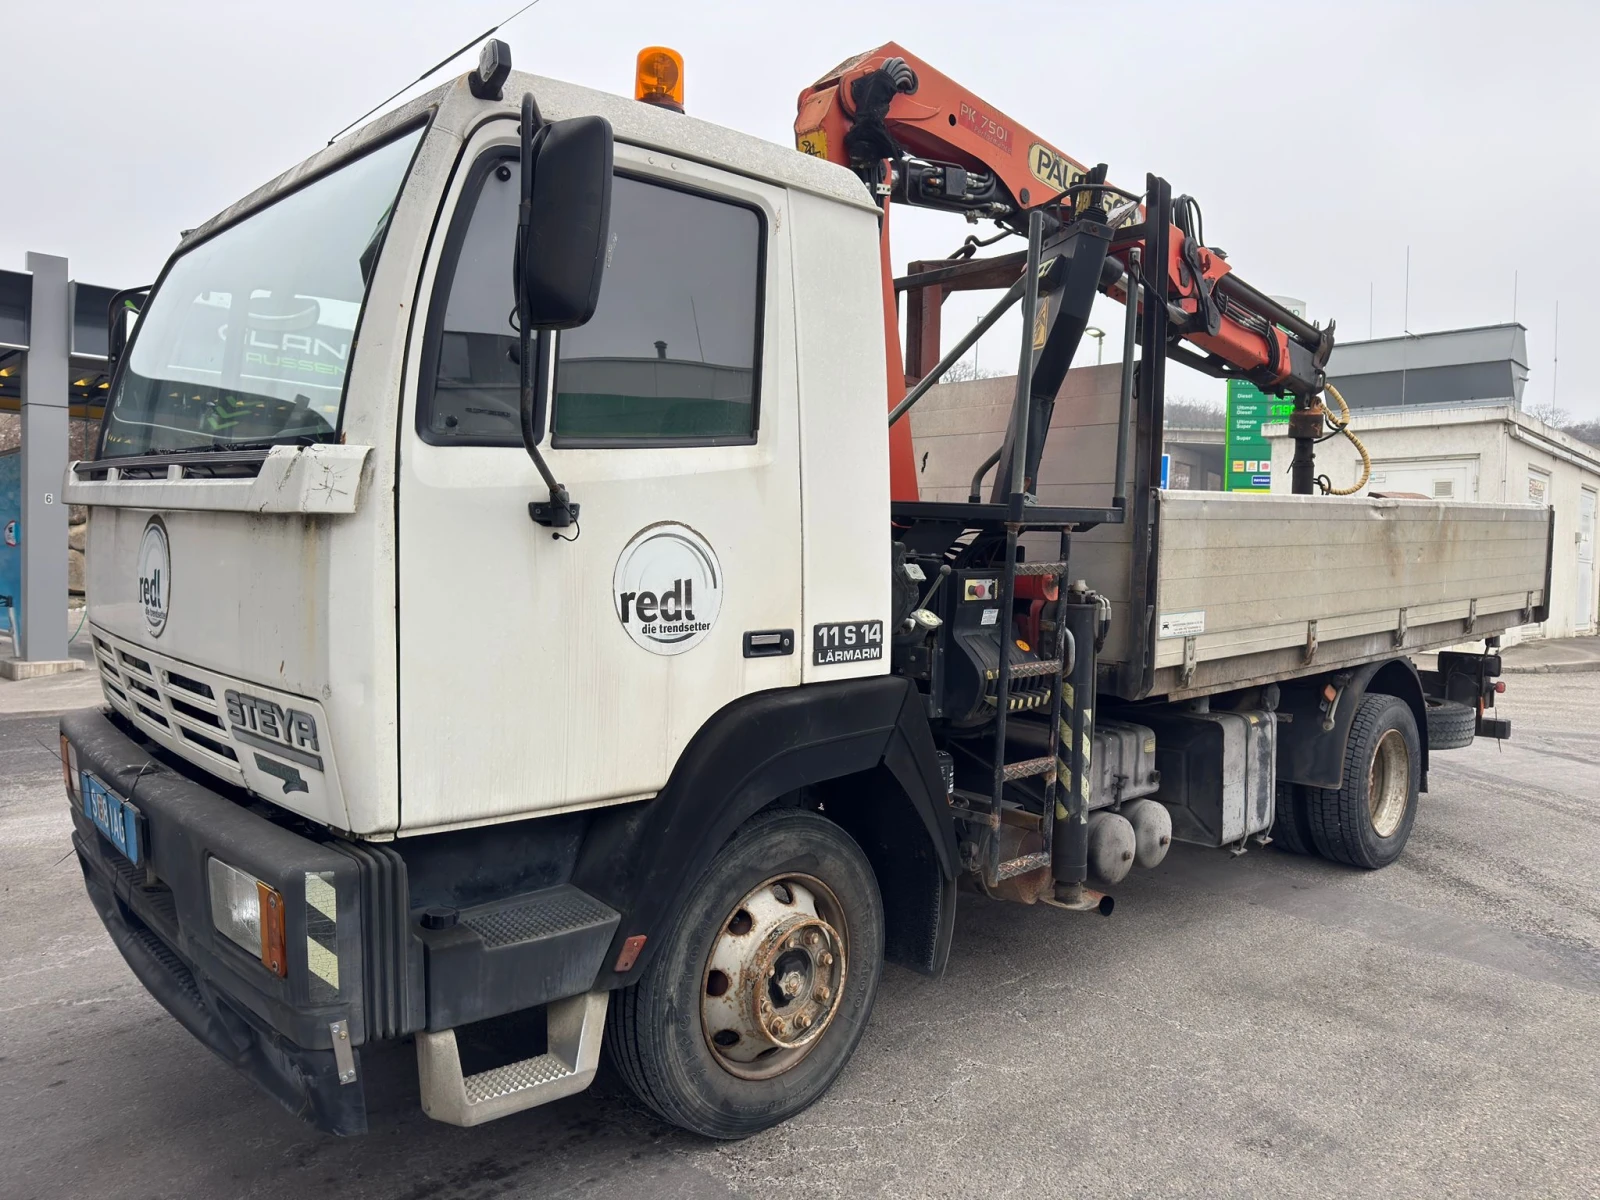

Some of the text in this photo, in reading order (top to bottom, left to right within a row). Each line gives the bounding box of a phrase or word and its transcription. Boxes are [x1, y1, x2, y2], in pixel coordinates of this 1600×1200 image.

[960, 103, 1008, 142] PK 7501
[45, 494, 53, 504] 6
[139, 568, 162, 609] redl
[620, 578, 696, 624] redl
[641, 621, 711, 634] die trendsetter
[818, 623, 881, 647] 11 S 14
[818, 647, 880, 663] LÄRMARM
[224, 688, 320, 752] STEYR
